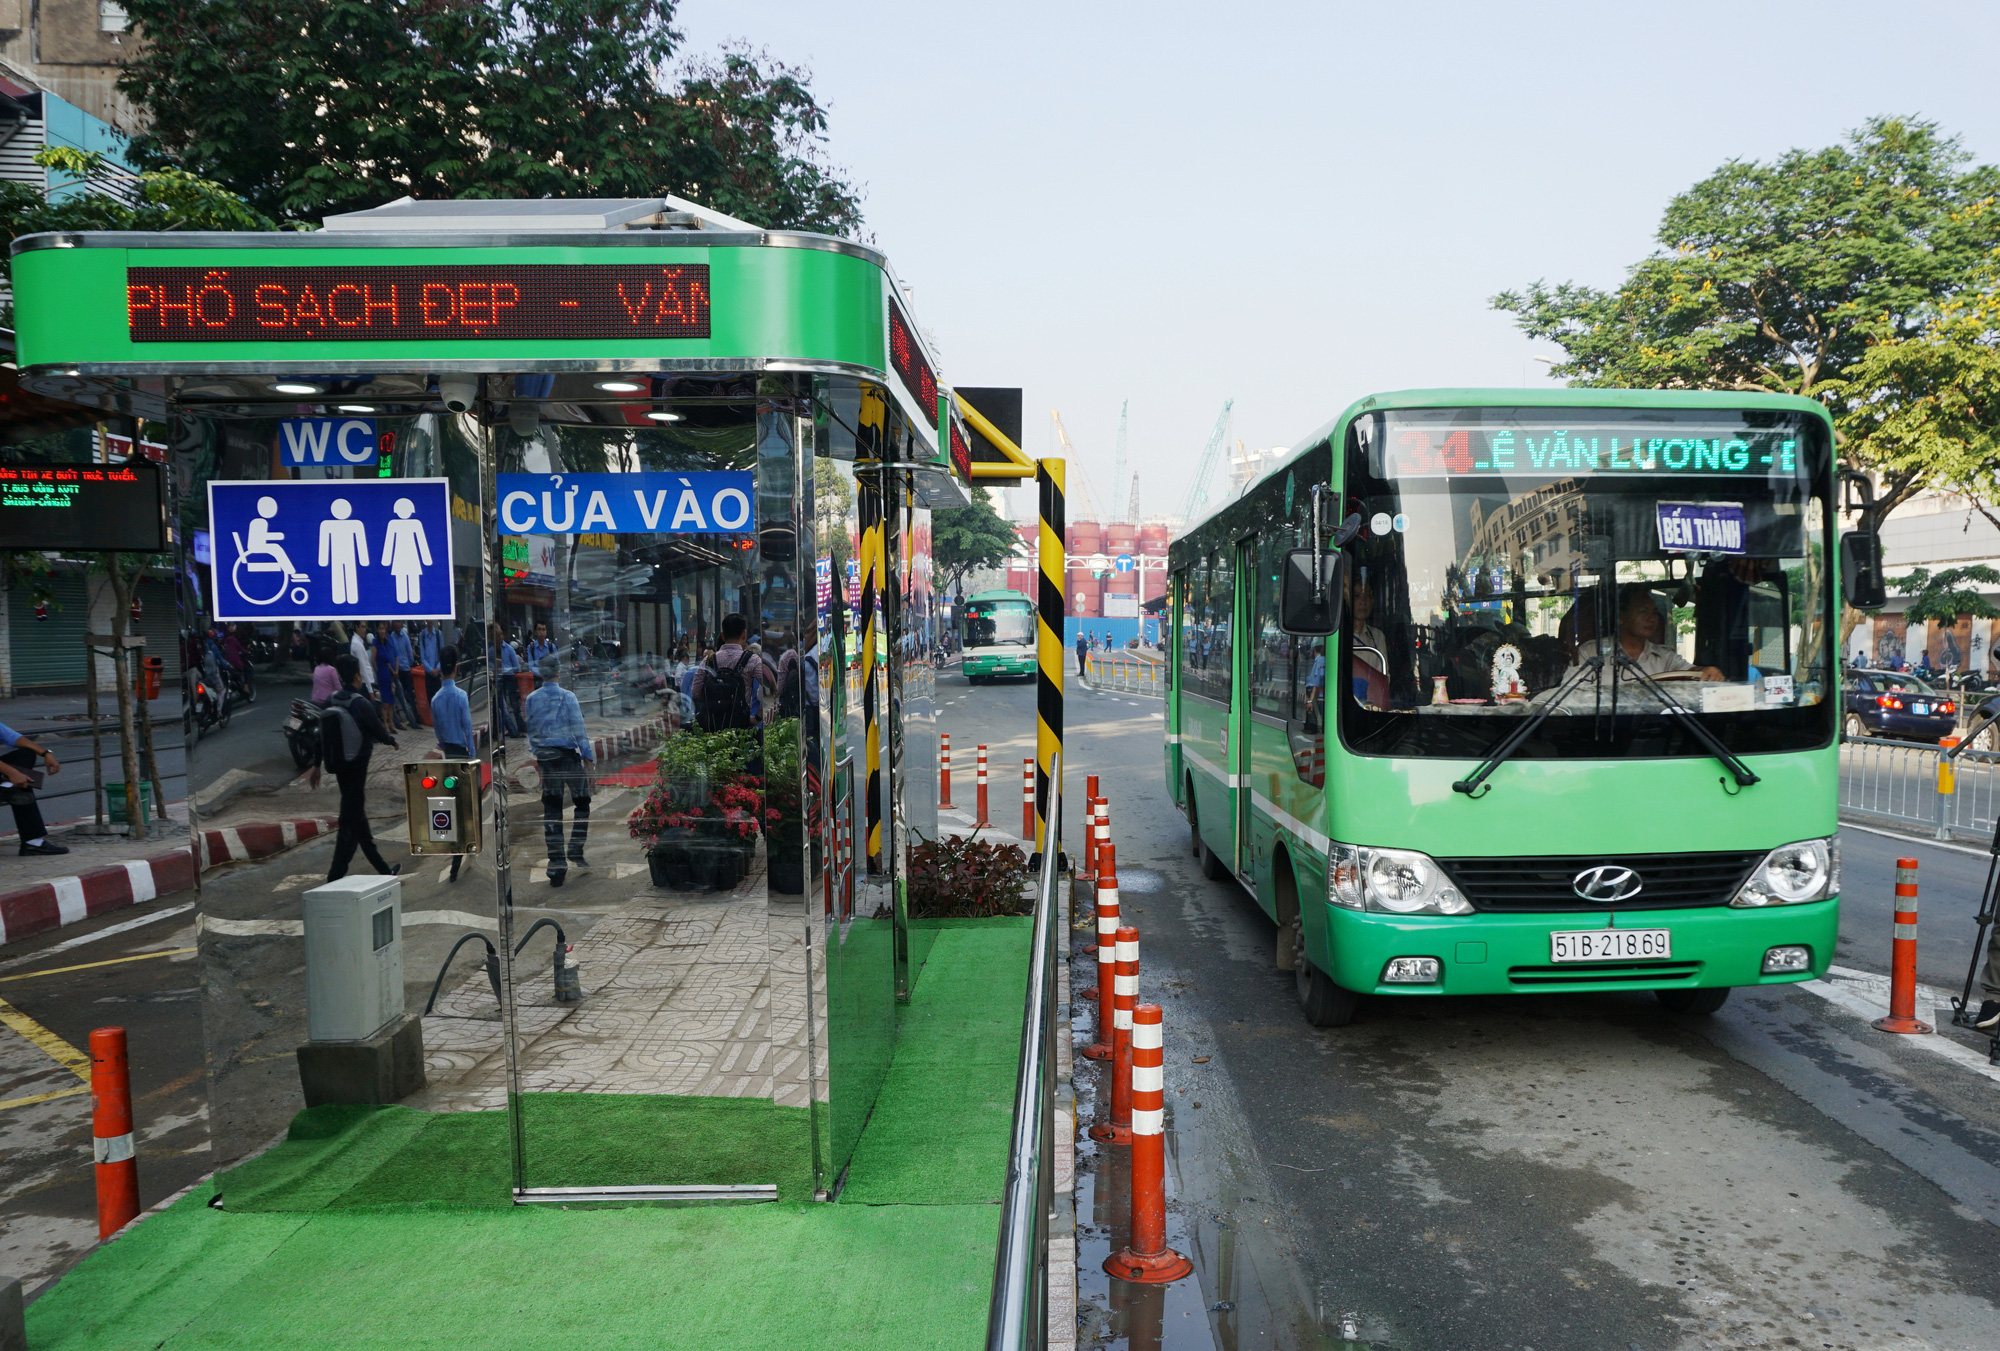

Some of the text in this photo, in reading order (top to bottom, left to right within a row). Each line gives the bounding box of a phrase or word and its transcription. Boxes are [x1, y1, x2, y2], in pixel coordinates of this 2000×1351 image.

[127, 271, 235, 327] PHỐ
[255, 284, 399, 335] SẠCH
[419, 283, 520, 334] ĐẸP
[281, 420, 373, 463] WC
[1398, 430, 1474, 474] 34
[1525, 429, 1599, 468] VĂN
[1611, 437, 1749, 471] LƯƠNG
[501, 475, 618, 532] CỬA
[633, 478, 750, 530] VÀO
[1662, 507, 1741, 549] BẾN THÀNH
[1555, 933, 1666, 957] 51B-218.69
